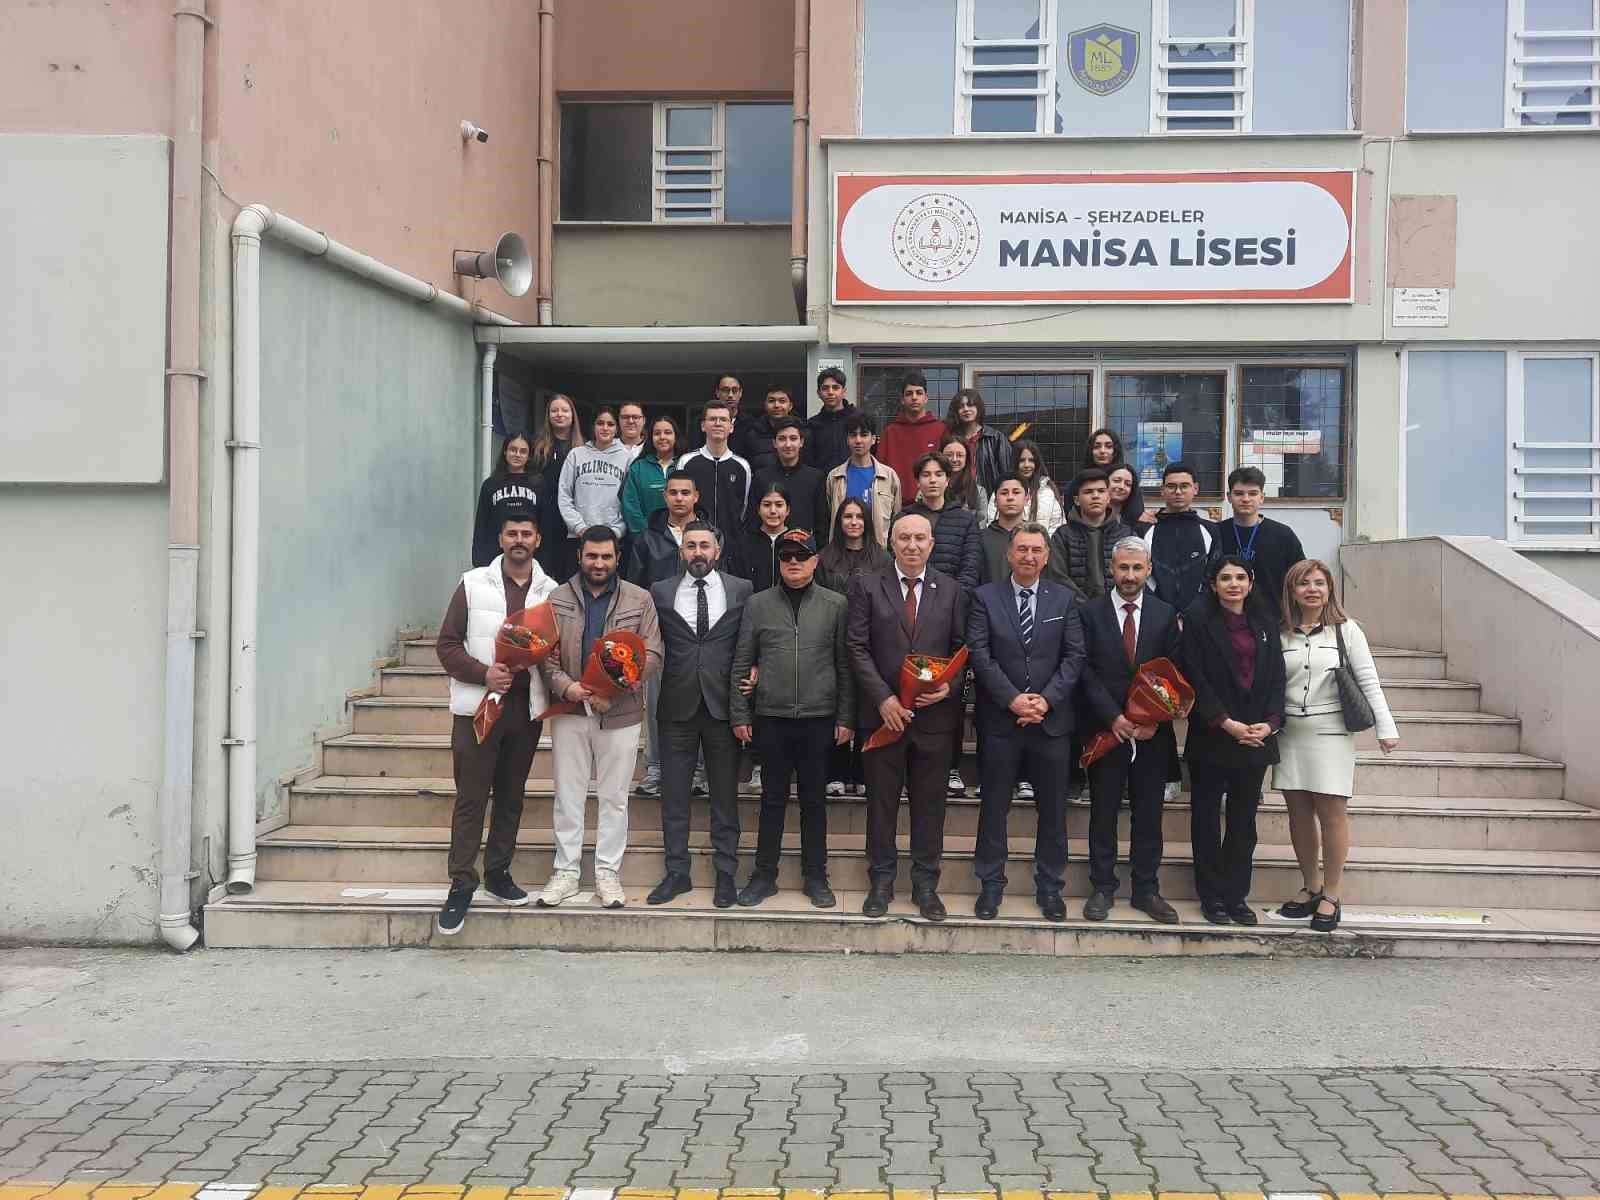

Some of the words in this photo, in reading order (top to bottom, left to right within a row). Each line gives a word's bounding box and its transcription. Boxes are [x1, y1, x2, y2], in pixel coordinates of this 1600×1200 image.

[1000, 207, 1068, 224] MANİSA
[1087, 209, 1205, 226] ŞEHZADELER
[999, 229, 1159, 267] MANİSA
[1170, 228, 1296, 266] LİSESİ
[575, 459, 625, 481] ARLINGTON
